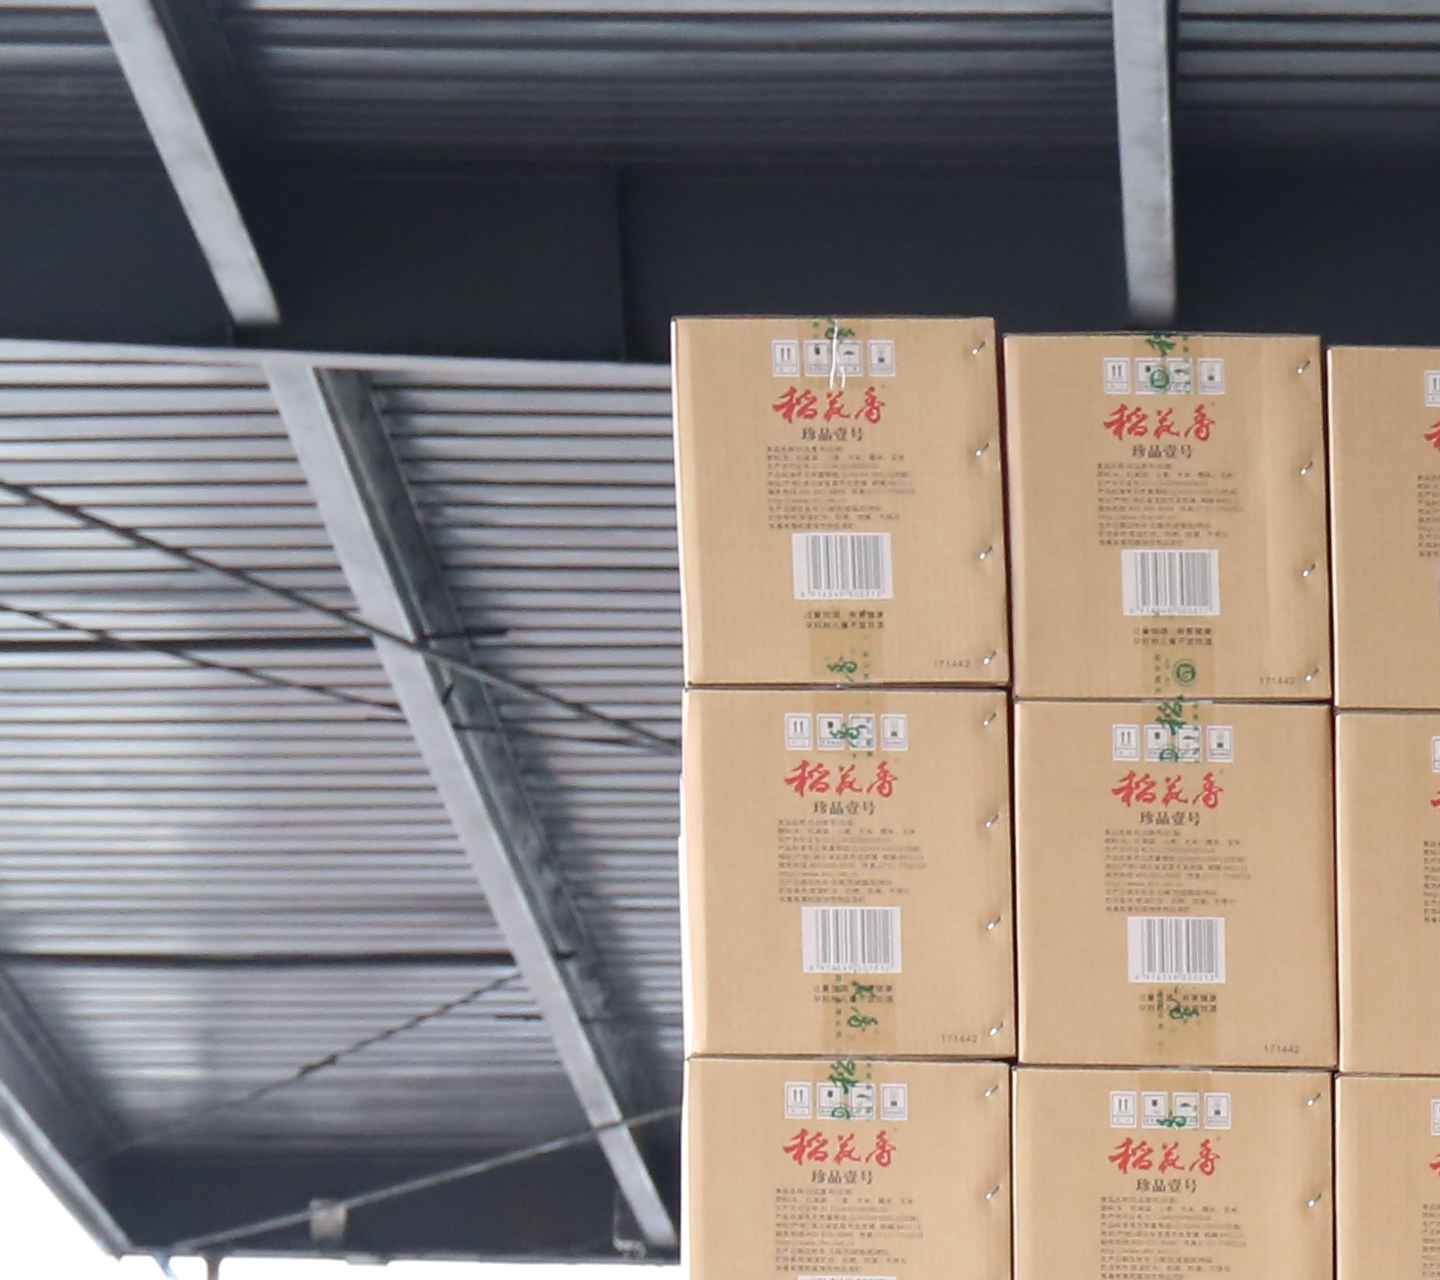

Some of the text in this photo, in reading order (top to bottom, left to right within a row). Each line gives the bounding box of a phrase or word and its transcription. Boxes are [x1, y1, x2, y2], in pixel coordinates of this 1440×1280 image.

[773, 385, 882, 426] 稻花香
[1103, 402, 1215, 442] 稻花香
[801, 426, 864, 443] 珍品壹号
[782, 758, 896, 799] 稻花香
[1110, 770, 1223, 811] 稻花香
[1139, 810, 1201, 827] 珍品壹号
[782, 1127, 895, 1169] 稻花香
[1108, 1136, 1218, 1178] 稻花香
